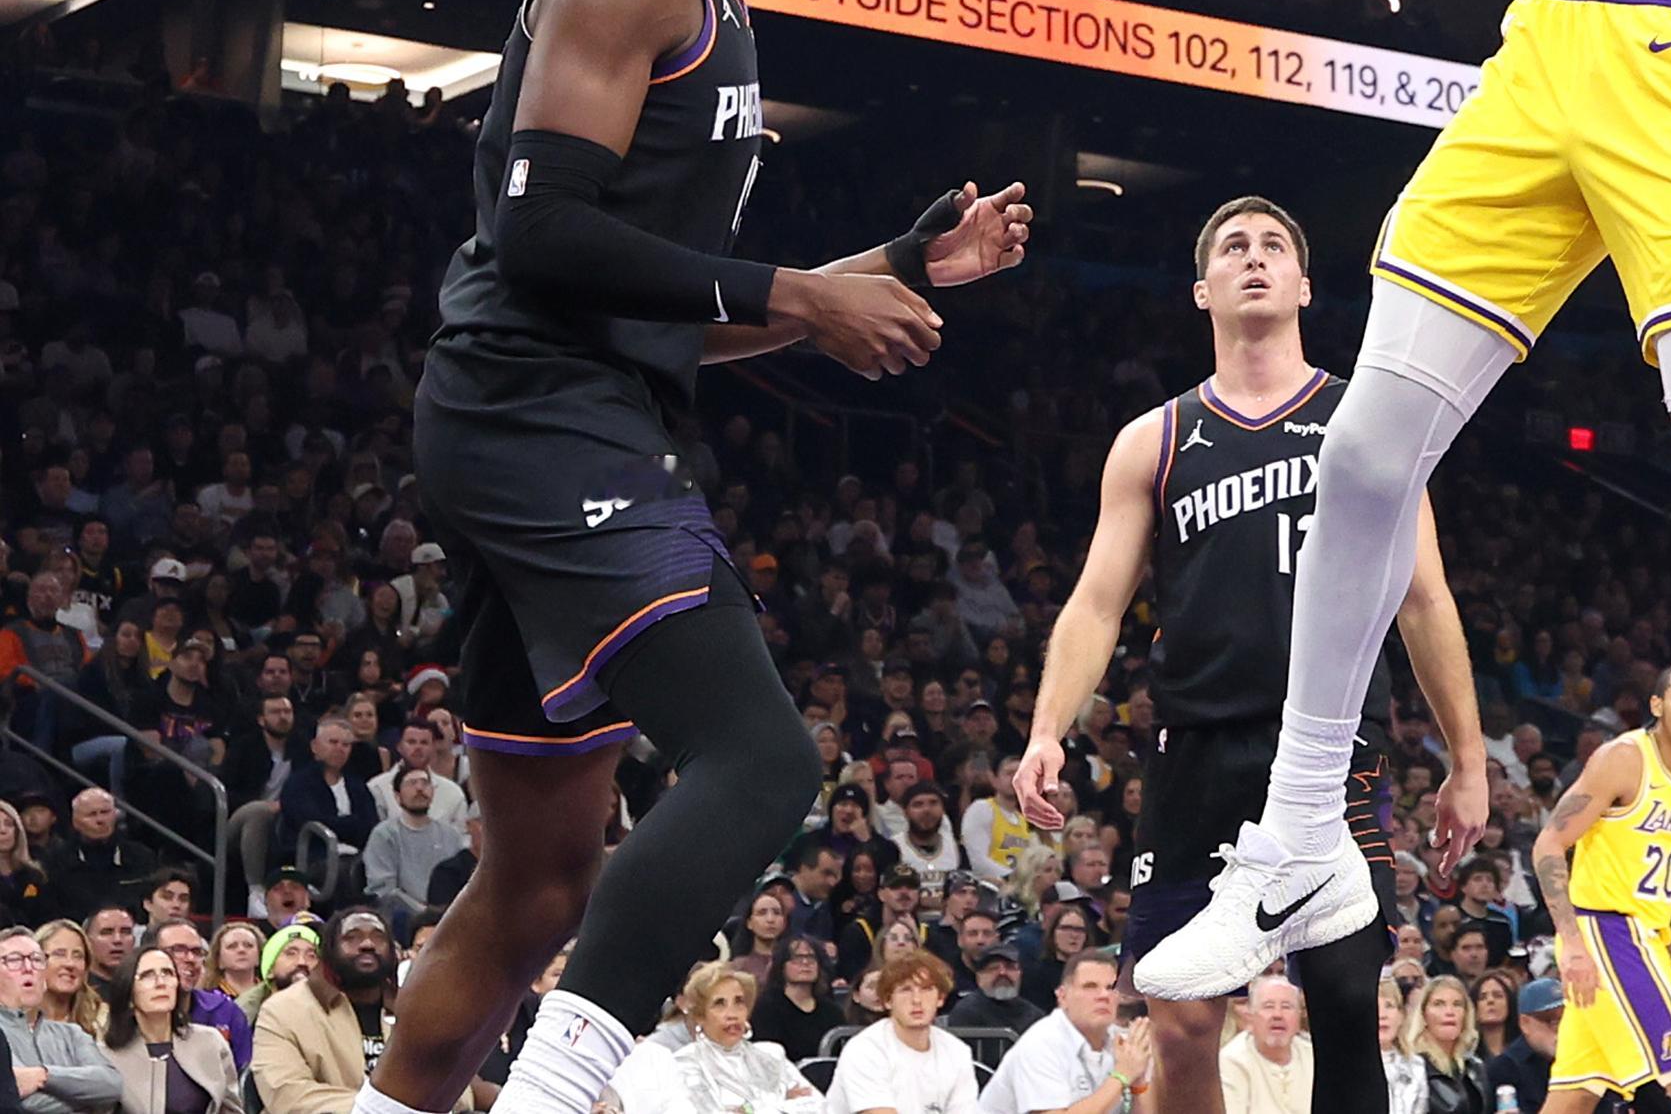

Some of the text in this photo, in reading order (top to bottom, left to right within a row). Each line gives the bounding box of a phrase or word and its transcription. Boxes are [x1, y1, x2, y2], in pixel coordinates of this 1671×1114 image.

[1168, 31, 1237, 79] 102,
[1248, 46, 1311, 92] 112,
[1324, 60, 1386, 105] 119,
[1395, 71, 1417, 107] &
[1284, 421, 1327, 438] PayPa
